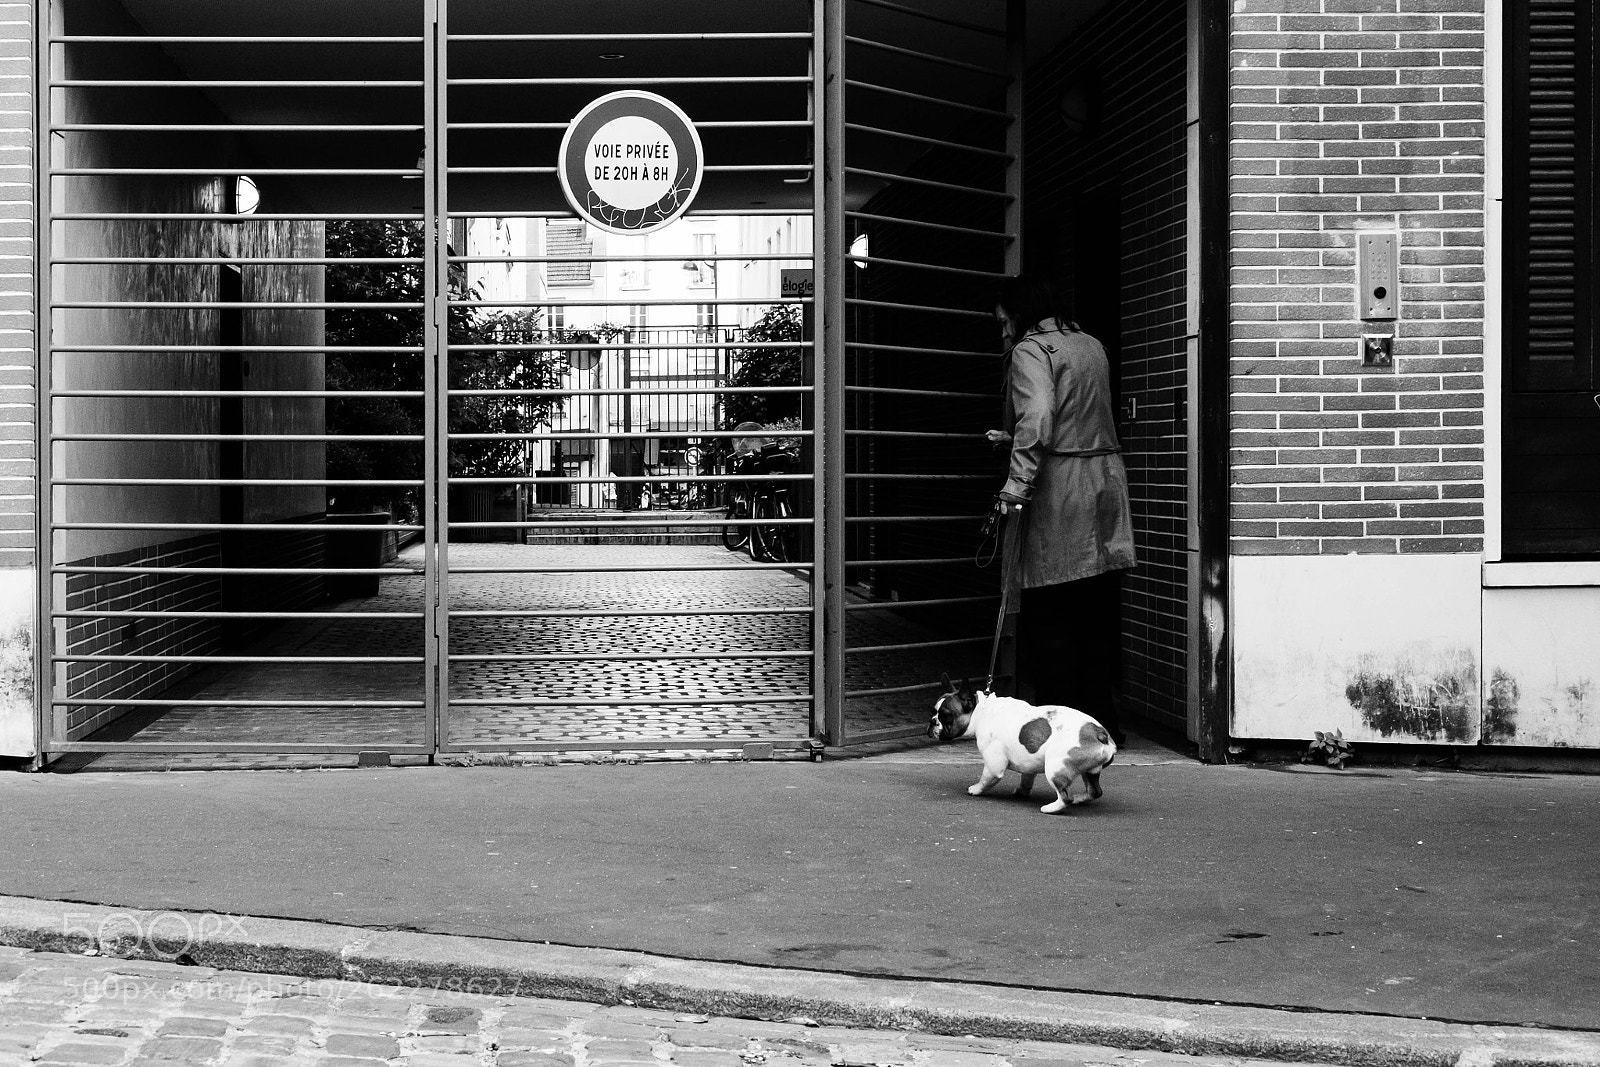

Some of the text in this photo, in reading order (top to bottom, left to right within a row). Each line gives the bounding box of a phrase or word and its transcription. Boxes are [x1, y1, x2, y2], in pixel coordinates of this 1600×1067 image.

[594, 141, 669, 158] VOIE PRIVÉE
[594, 163, 669, 181] DE 20H À 8H
